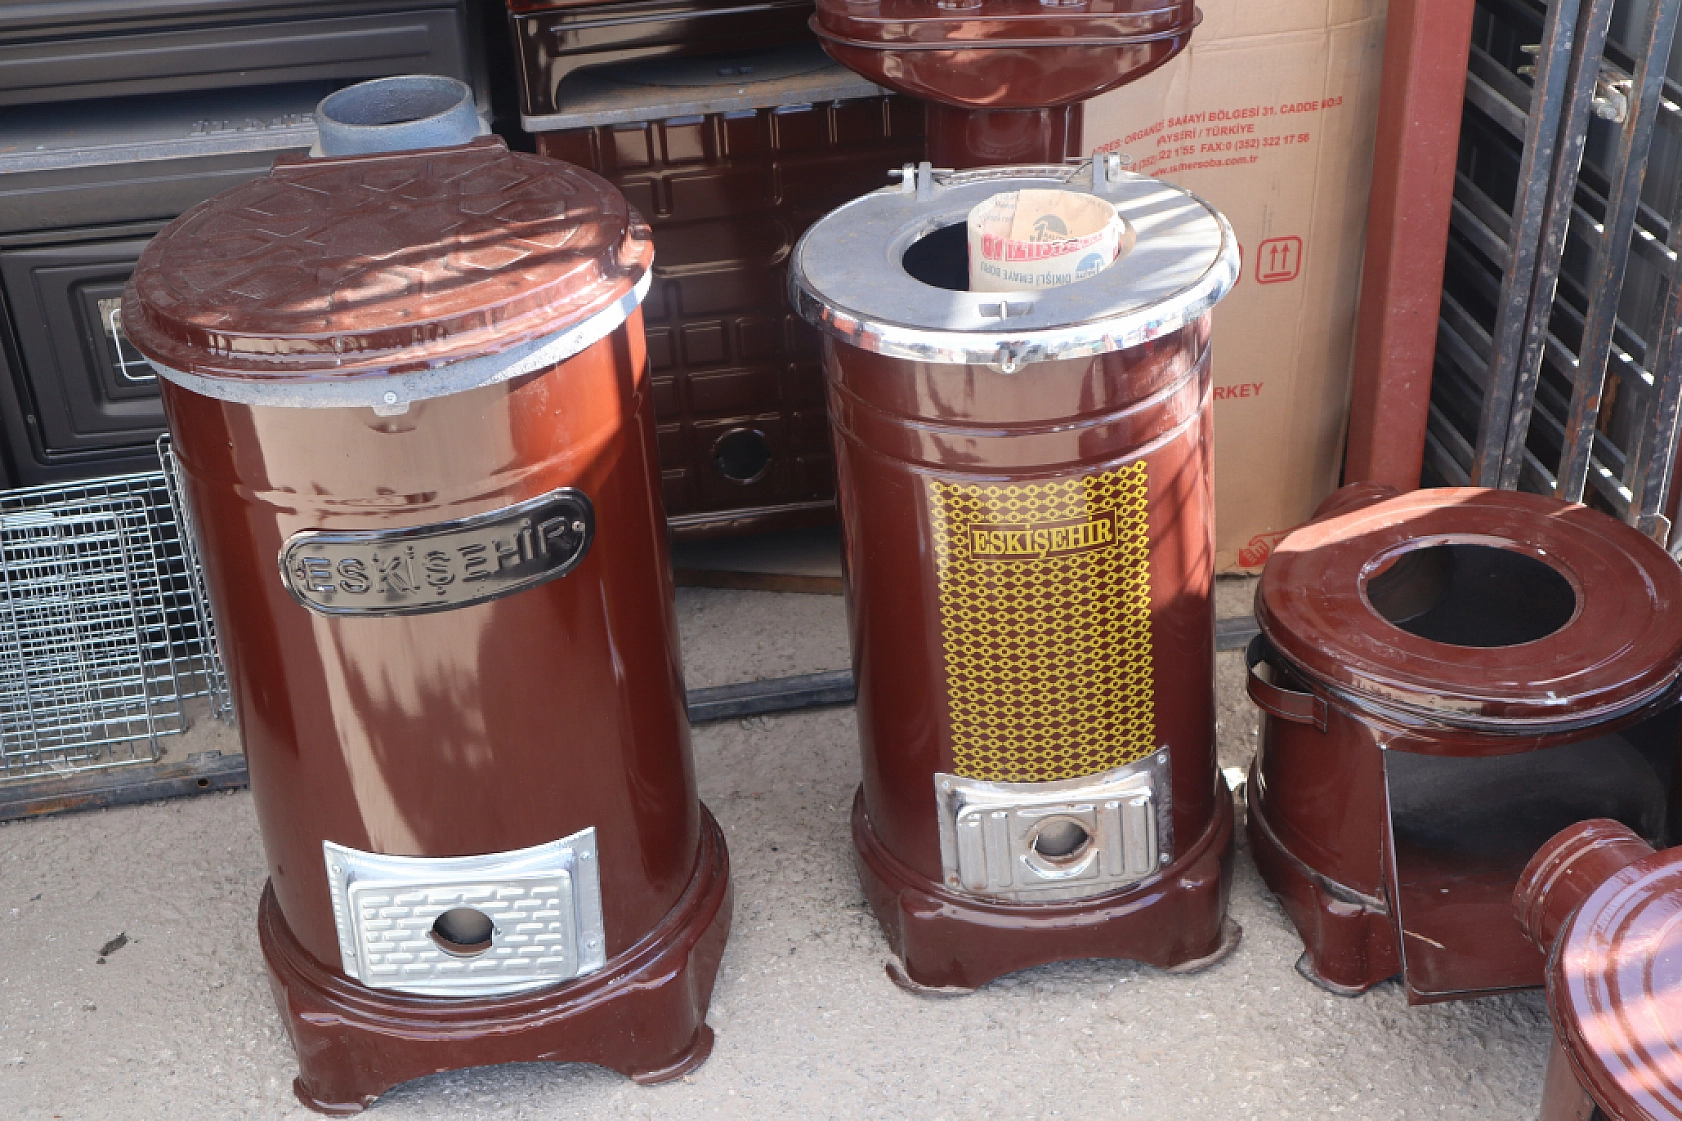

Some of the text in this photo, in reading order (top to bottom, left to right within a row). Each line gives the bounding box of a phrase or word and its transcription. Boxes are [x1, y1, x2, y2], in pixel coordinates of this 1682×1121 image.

[1208, 104, 1259, 122] BÖLGESİ
[1262, 105, 1277, 117] 31.
[1280, 100, 1319, 114] CADDE
[1205, 122, 1255, 138] TÜRKİYE
[972, 516, 1113, 559] ESKİŞEHİR
[301, 516, 572, 596] ESKİŞEHİR
